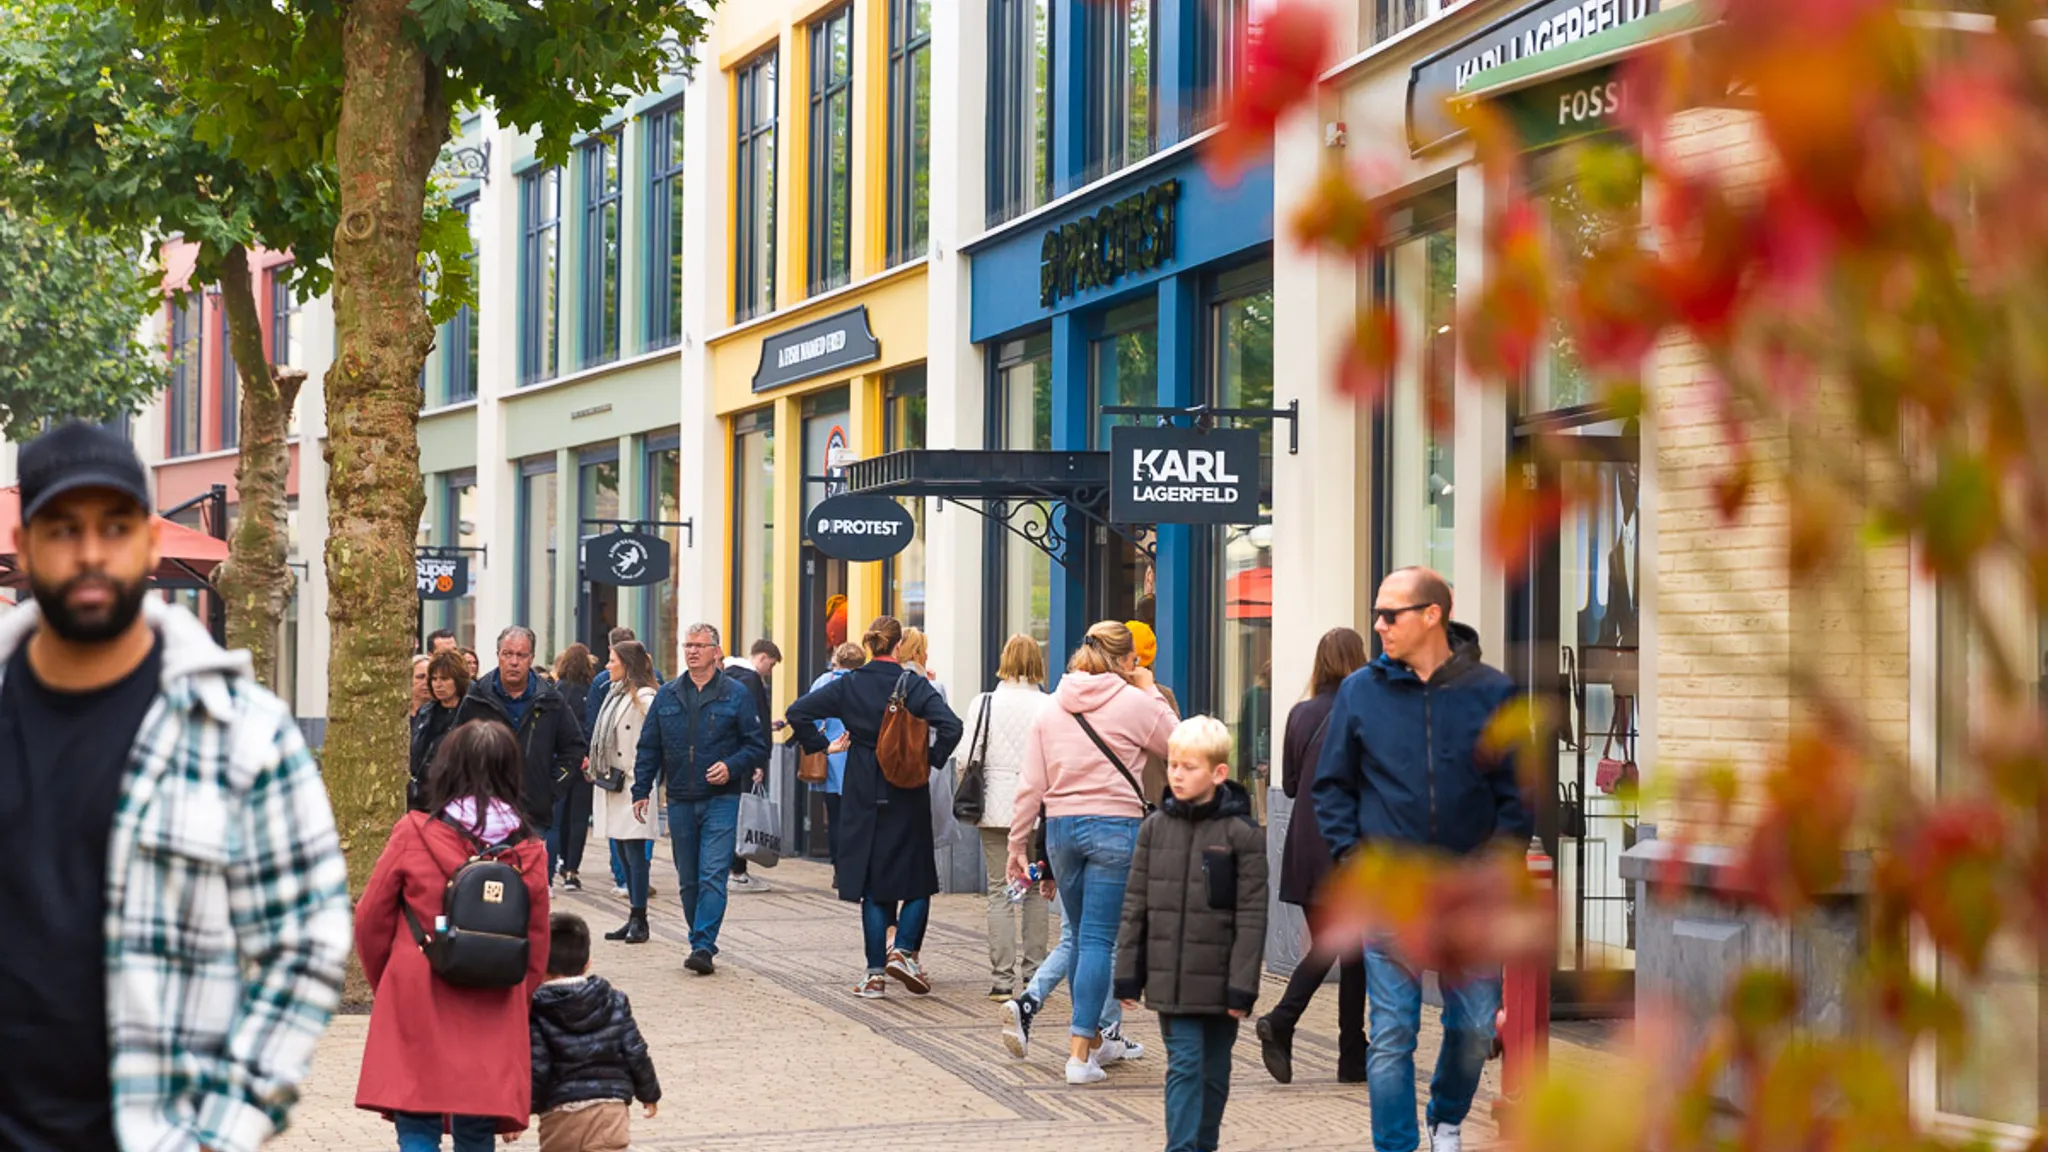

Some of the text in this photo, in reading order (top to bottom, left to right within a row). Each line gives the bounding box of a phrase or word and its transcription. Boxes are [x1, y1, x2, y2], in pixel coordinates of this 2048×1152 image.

[1133, 449, 1239, 483] KARL
[1133, 486, 1239, 503] LAGERFELD
[834, 520, 902, 535] PROTEST
